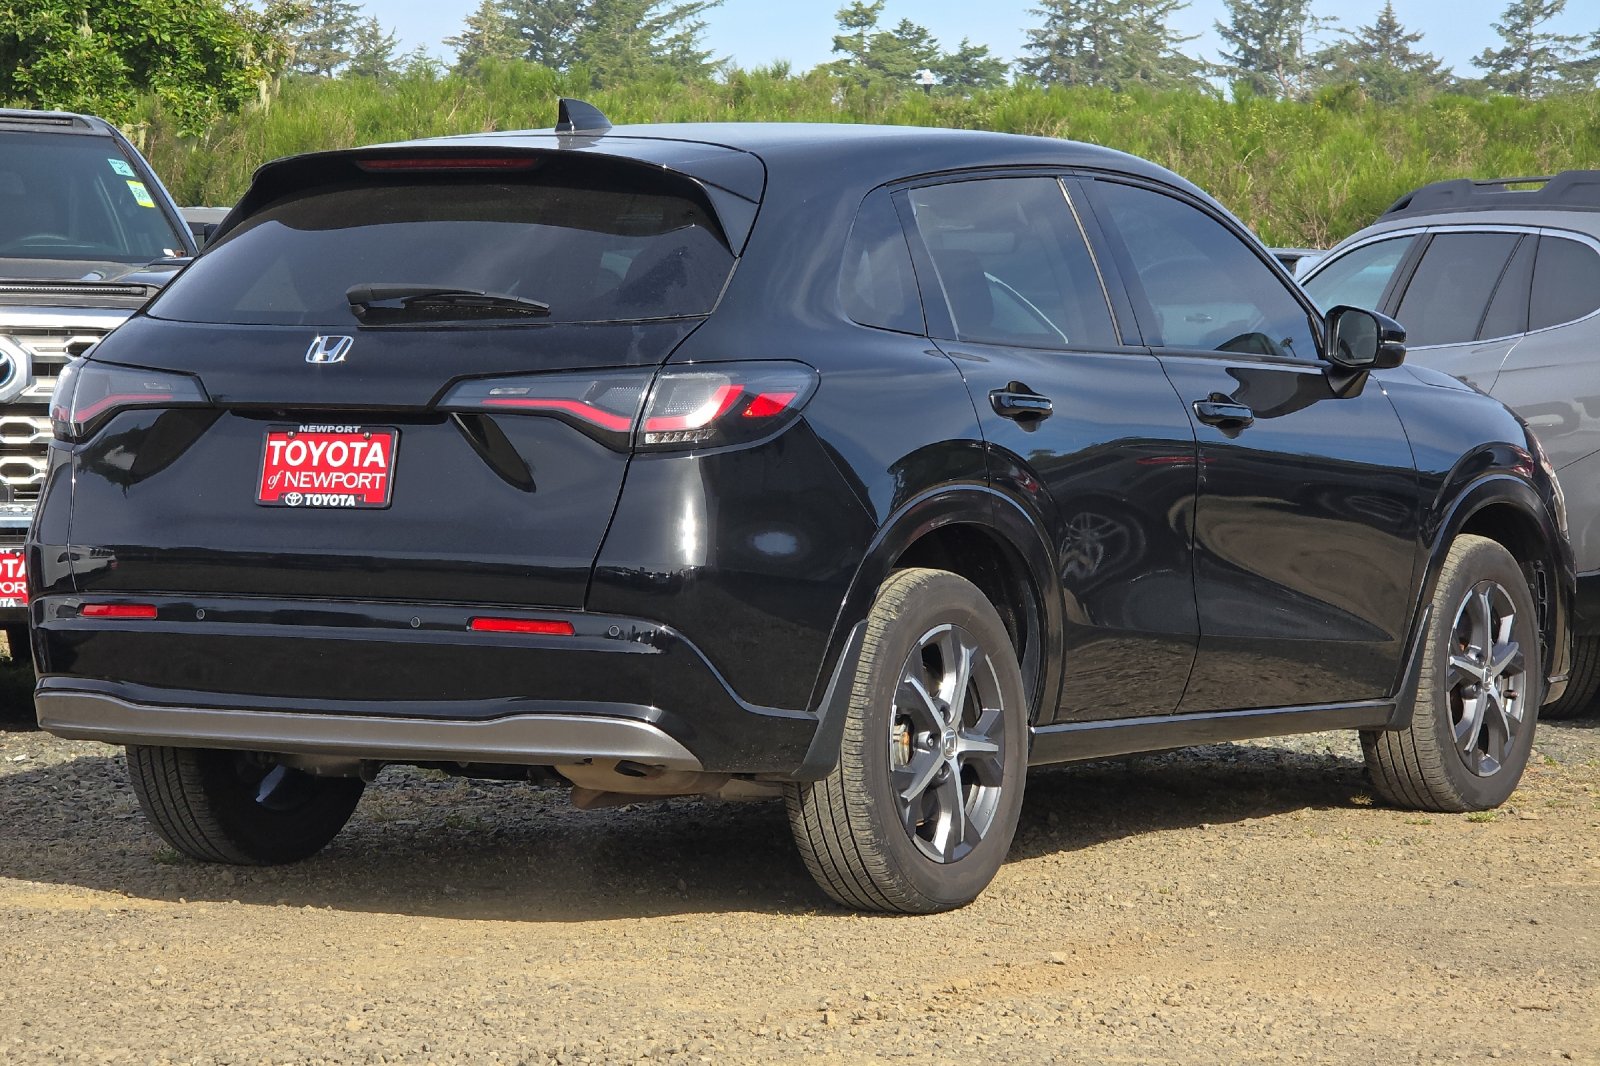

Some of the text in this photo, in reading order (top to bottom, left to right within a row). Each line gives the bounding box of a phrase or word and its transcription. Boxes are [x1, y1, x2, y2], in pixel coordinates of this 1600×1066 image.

[299, 425, 361, 433] NEWPORT
[269, 440, 386, 468] TOYOTA
[267, 470, 386, 489] of NEWPORT
[305, 493, 356, 506] TOYOTA
